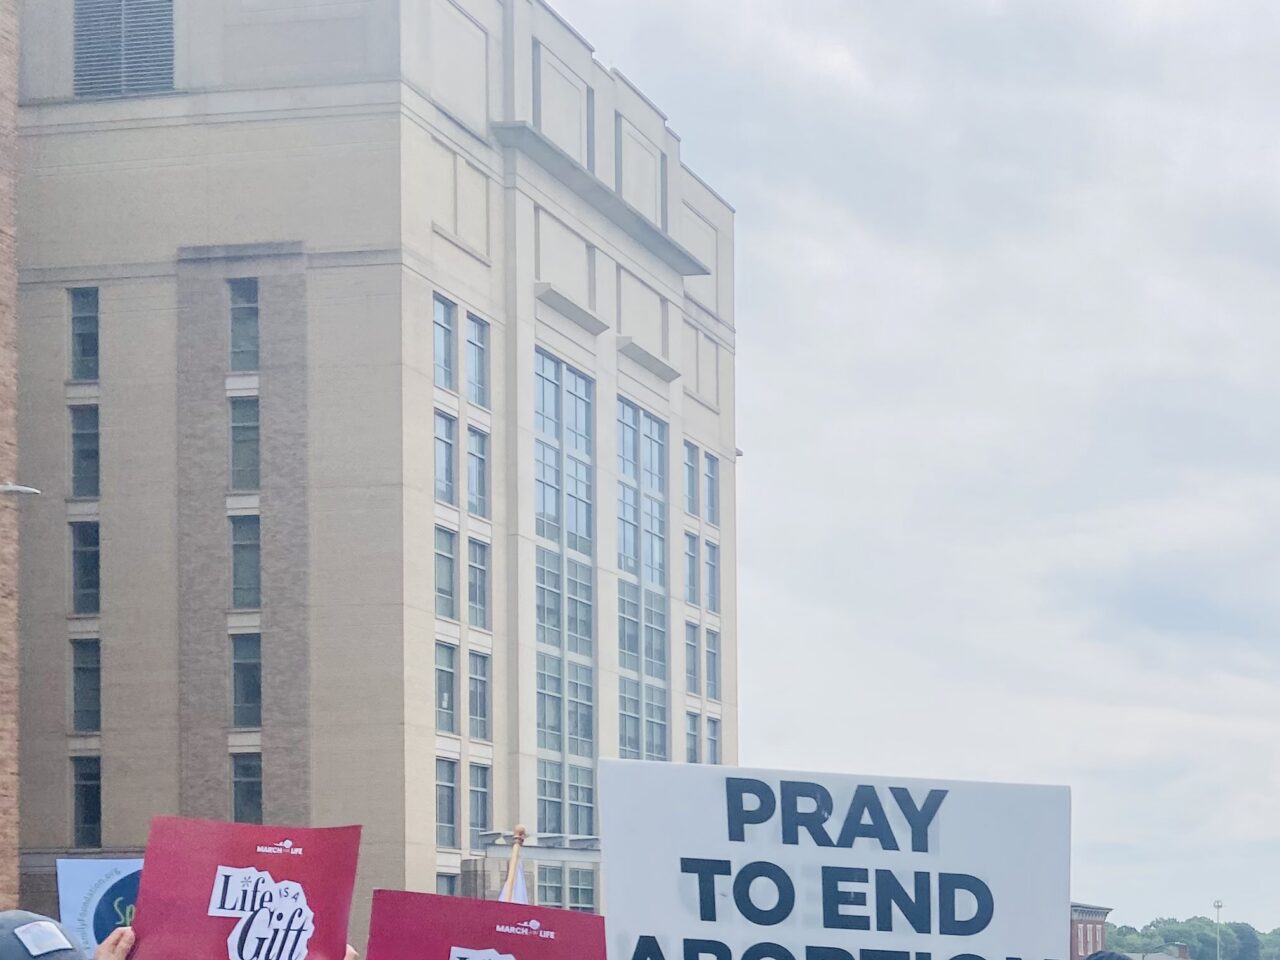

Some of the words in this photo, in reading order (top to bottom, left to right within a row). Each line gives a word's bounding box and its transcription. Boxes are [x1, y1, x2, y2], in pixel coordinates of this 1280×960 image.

[725, 777, 949, 852] PRAY
[256, 845, 283, 853] MARCH
[290, 847, 303, 855] LIFE
[217, 873, 273, 911] Life
[279, 886, 289, 898] IS
[291, 891, 300, 902] A
[680, 857, 795, 926] TO
[821, 865, 995, 936] END
[496, 924, 529, 935] MARCH
[540, 930, 555, 939] LIFE
